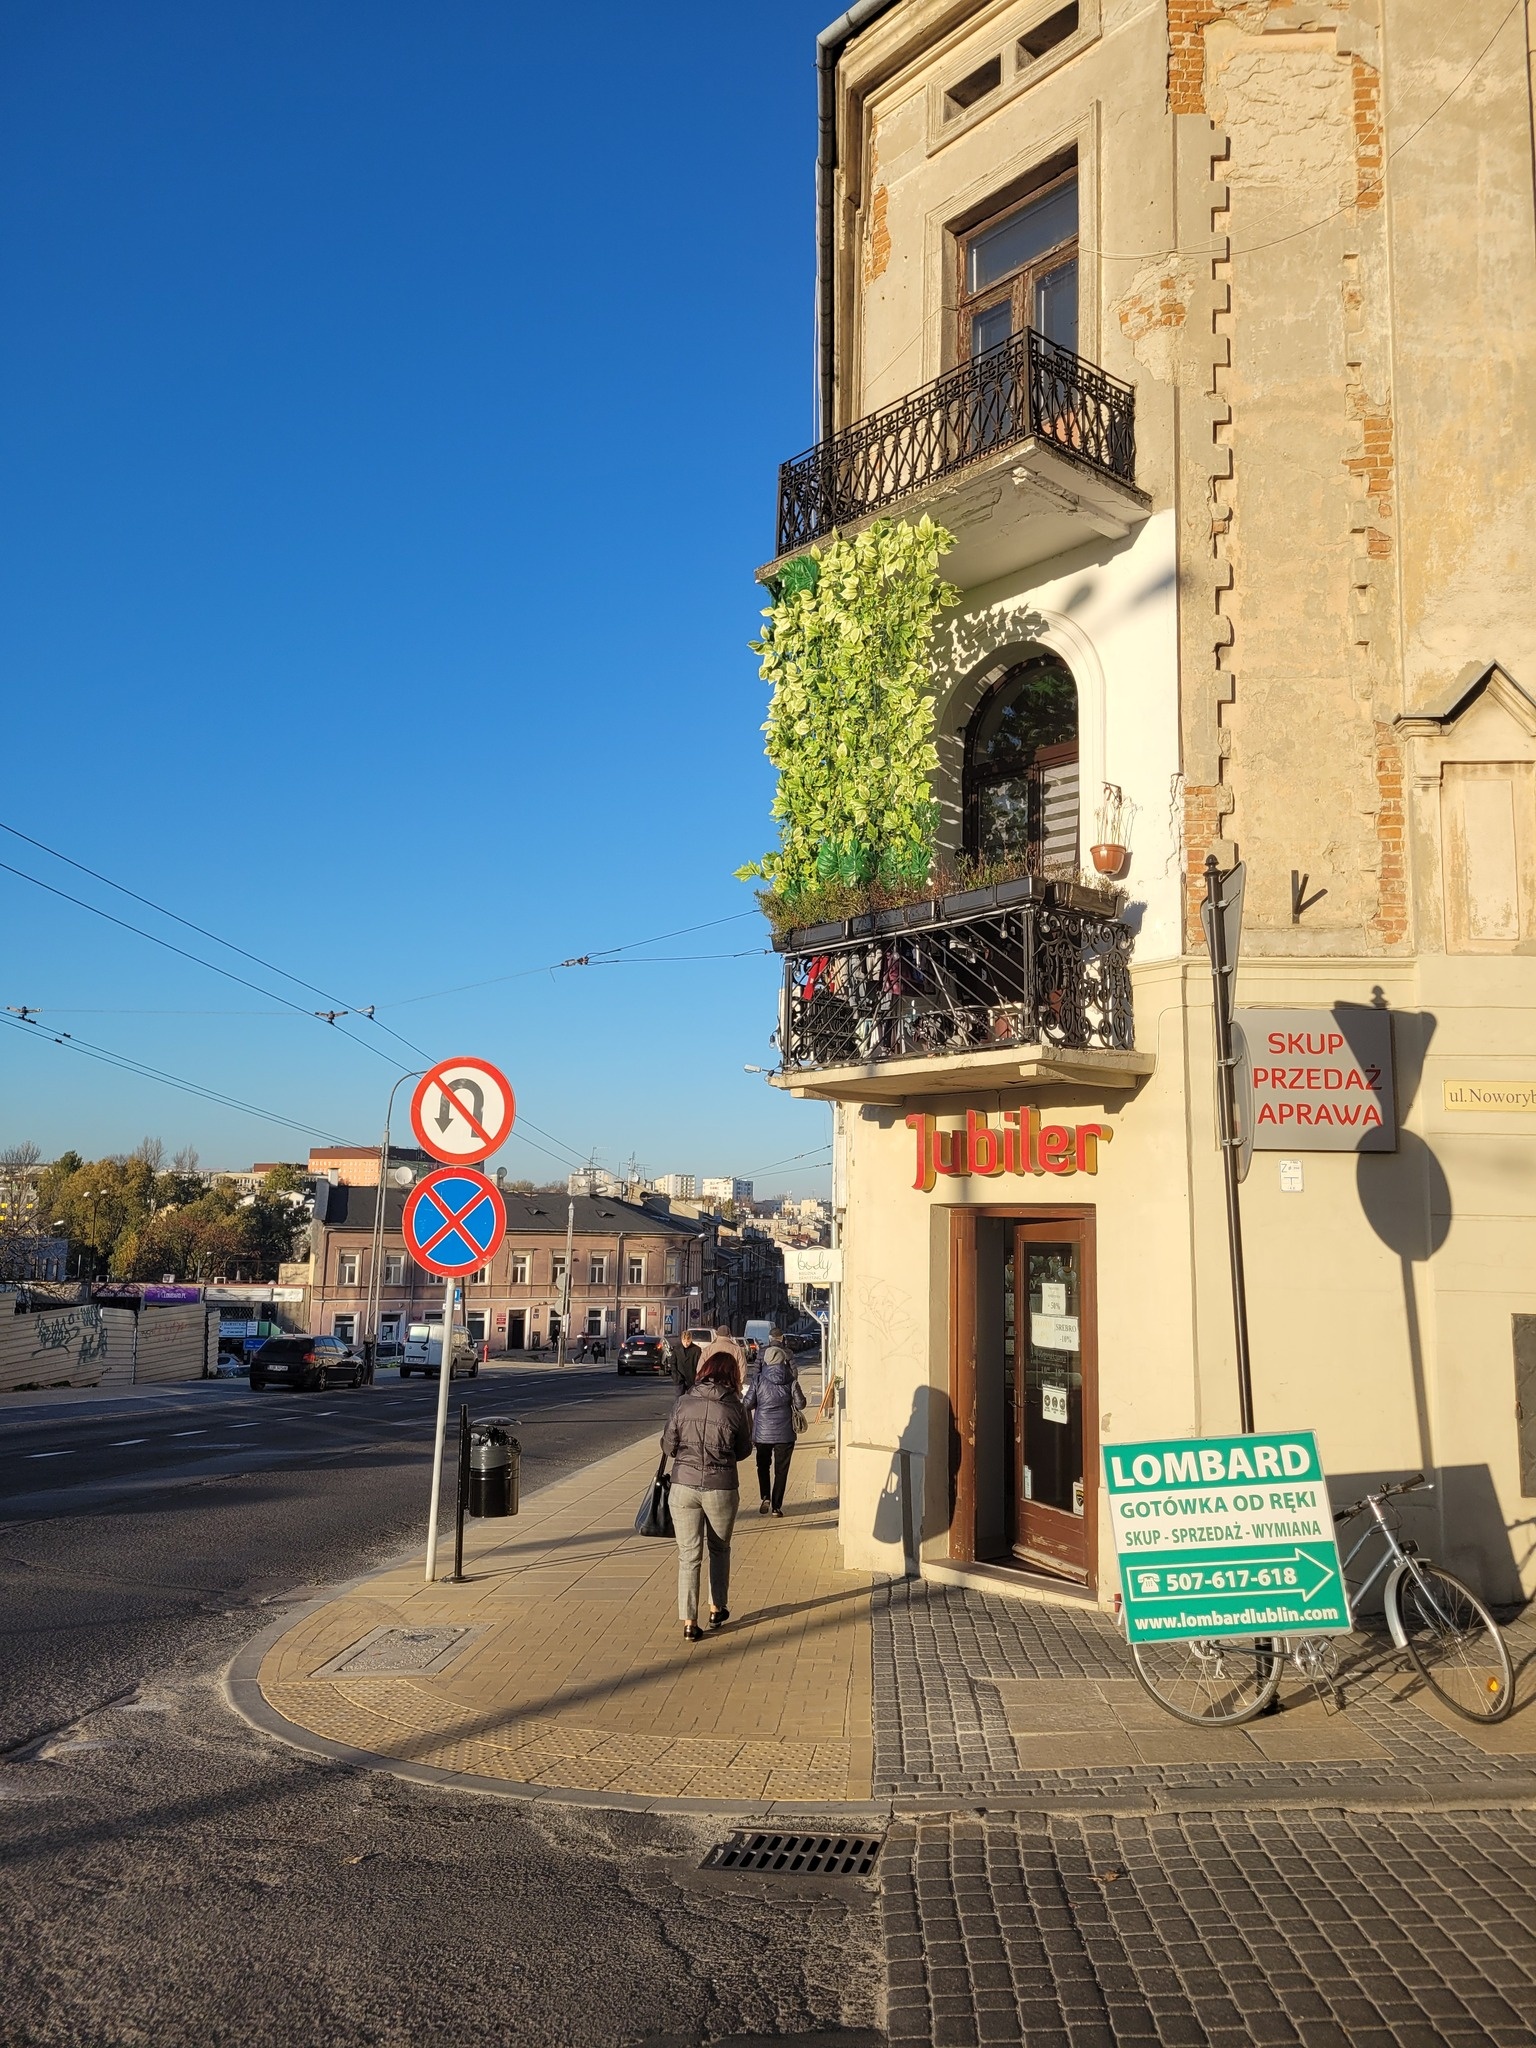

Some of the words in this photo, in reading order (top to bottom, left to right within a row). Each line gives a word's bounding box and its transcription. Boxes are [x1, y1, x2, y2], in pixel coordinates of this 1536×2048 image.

[1268, 1032, 1344, 1055] SKUP
[1252, 1063, 1383, 1091] PRZEDAŻ
[1257, 1102, 1383, 1126] APRAWA
[905, 1105, 1108, 1190] Jubiler
[797, 1251, 832, 1279] body
[1055, 1324, 1077, 1333] SREBRO
[1111, 1444, 1310, 1487] LOMBARD
[1120, 1496, 1228, 1518] GOTÓWKA
[1233, 1494, 1264, 1512] OD
[1269, 1490, 1317, 1514] RĘKI
[1125, 1528, 1161, 1546] SKUP
[1171, 1521, 1242, 1543] SPRZEDAŻ
[1252, 1520, 1322, 1539] WYMIANA
[1167, 1567, 1297, 1591] 507-617-618
[1135, 1607, 1339, 1630] www.lombardlublin.com
